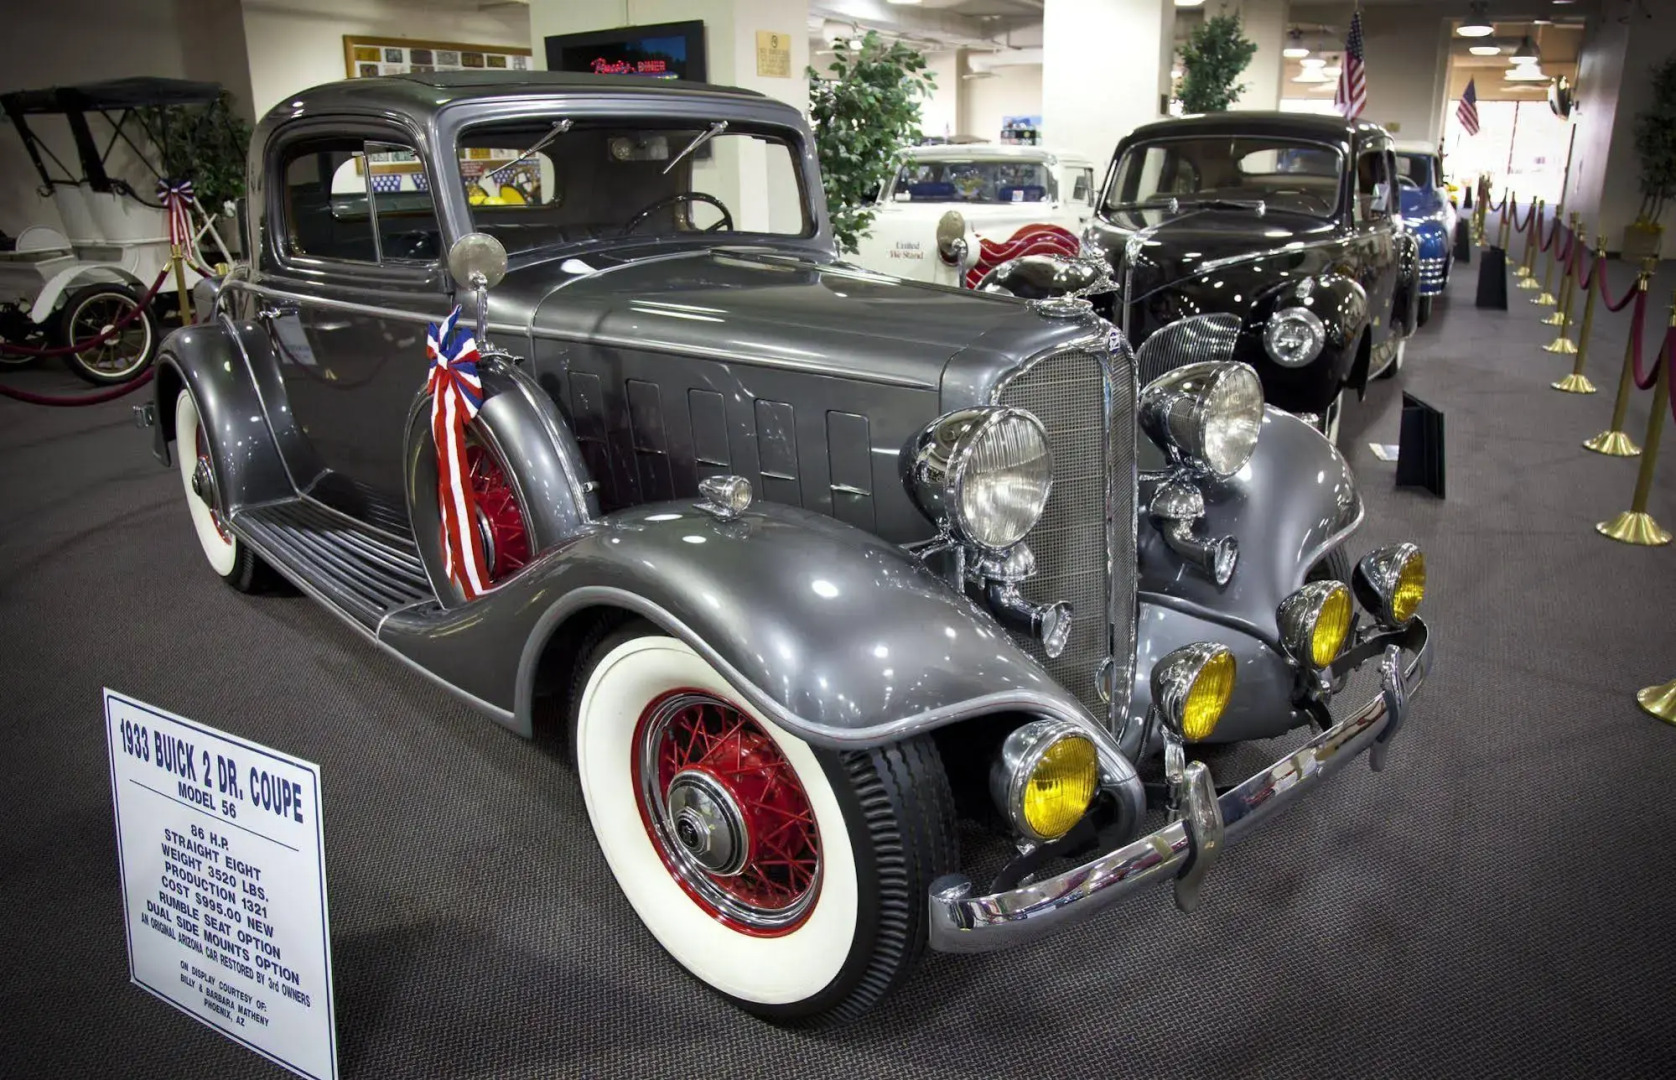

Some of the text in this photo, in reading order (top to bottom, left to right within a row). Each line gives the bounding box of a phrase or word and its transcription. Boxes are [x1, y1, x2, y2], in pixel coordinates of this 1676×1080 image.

[120, 718, 304, 824] 1933 BUICK 2 DR. COUPE
[178, 781, 237, 819] MODEL 56
[164, 828, 261, 881] STRAIGHT EIGHT
[191, 824, 229, 851] 86 H.P.
[161, 843, 269, 902] WEIGHT 3520 LBS.
[164, 861, 267, 919] PRODUCTION 1321
[159, 890, 281, 960] RUMBLE SEAT OPTION
[161, 875, 274, 938] COST $995.00 NEW
[141, 912, 311, 1008] AN ORIGINAL ARIZONA CAR RESTORED BY 3rd OWNERS
[146, 899, 300, 986] DUAL SIDE MOUNTS OPTION
[180, 960, 267, 1012] ON DISPLAY COURTESY OF:
[180, 973, 269, 1028] BILLY & BARBARA MATHENY
[204, 998, 246, 1027] PHOENIX, AZ
